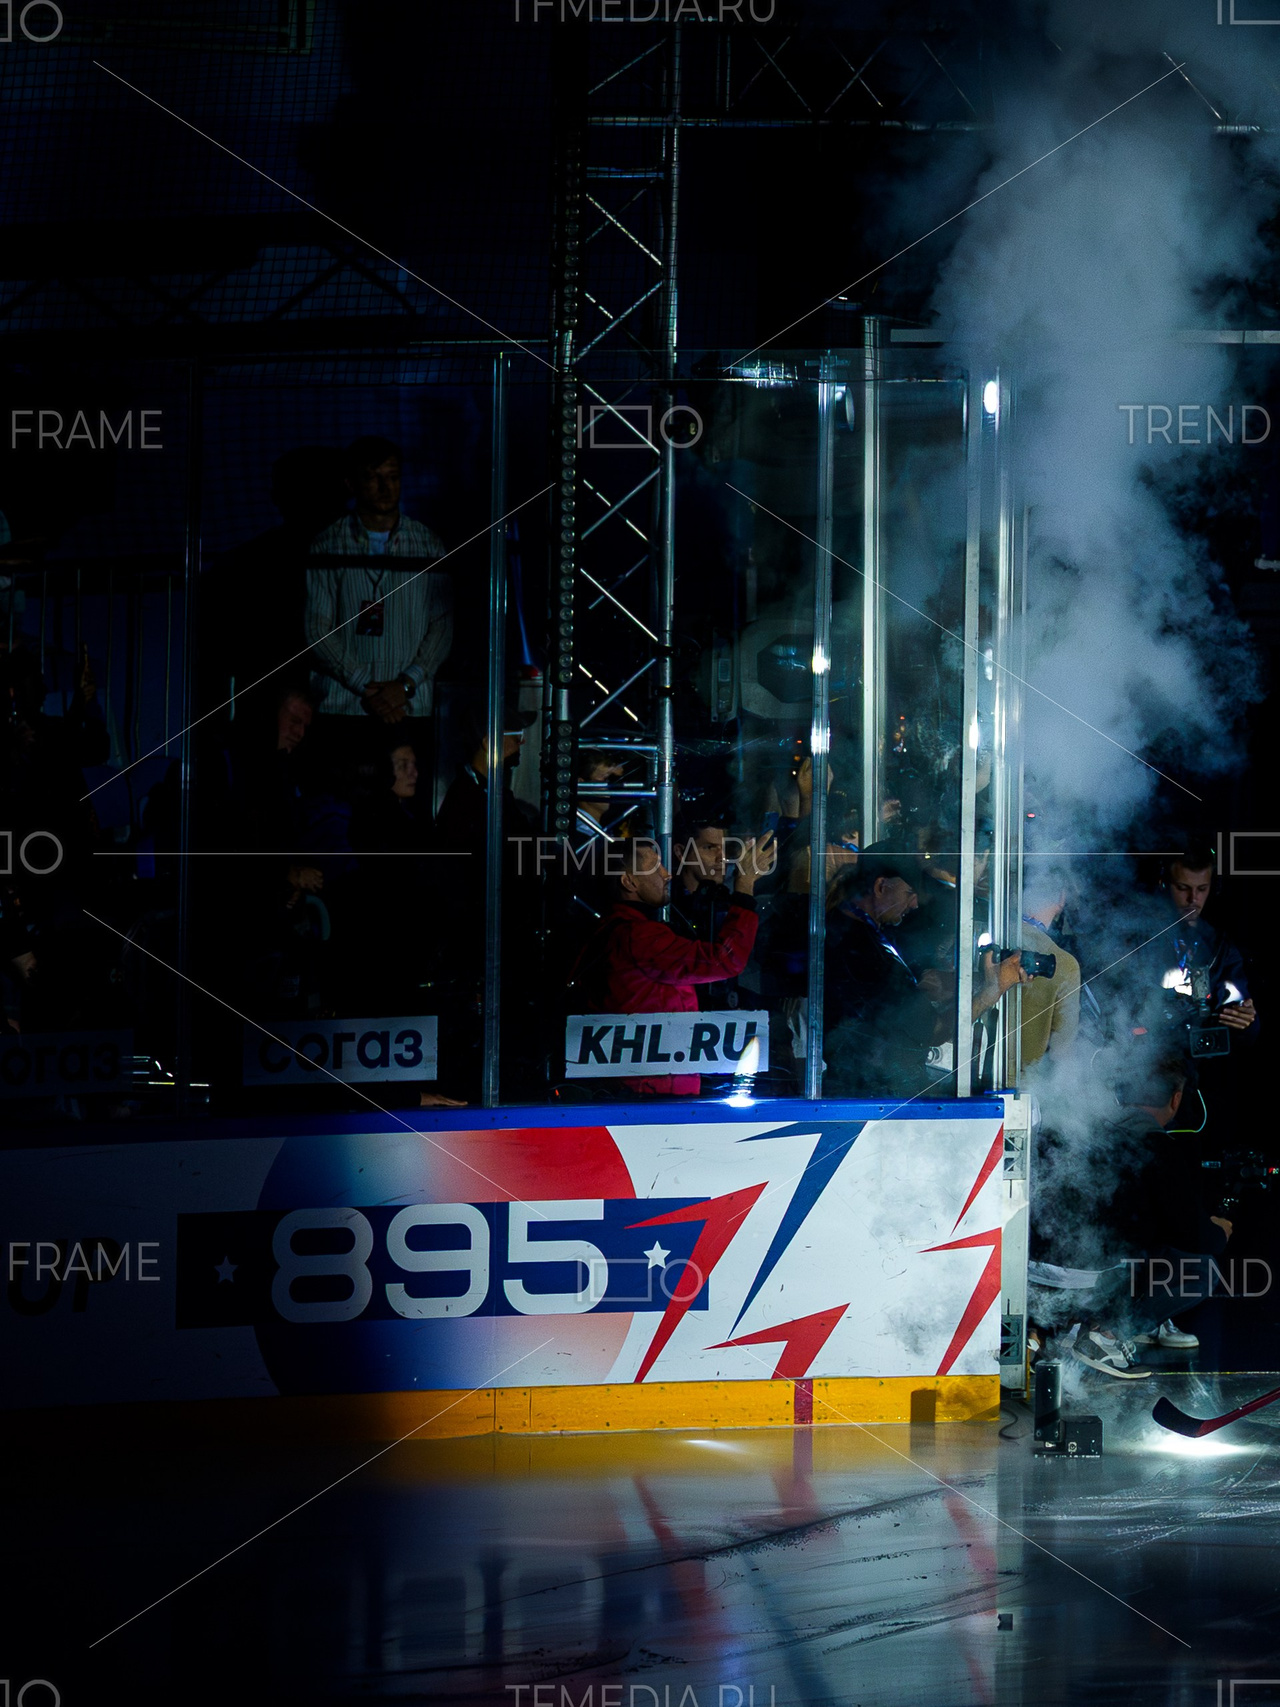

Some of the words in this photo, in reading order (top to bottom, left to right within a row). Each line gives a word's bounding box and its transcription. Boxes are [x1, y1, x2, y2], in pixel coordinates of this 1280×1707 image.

[258, 1029, 423, 1074] согаз
[578, 1022, 757, 1064] KHL.RU
[271, 1198, 609, 1324] 895
